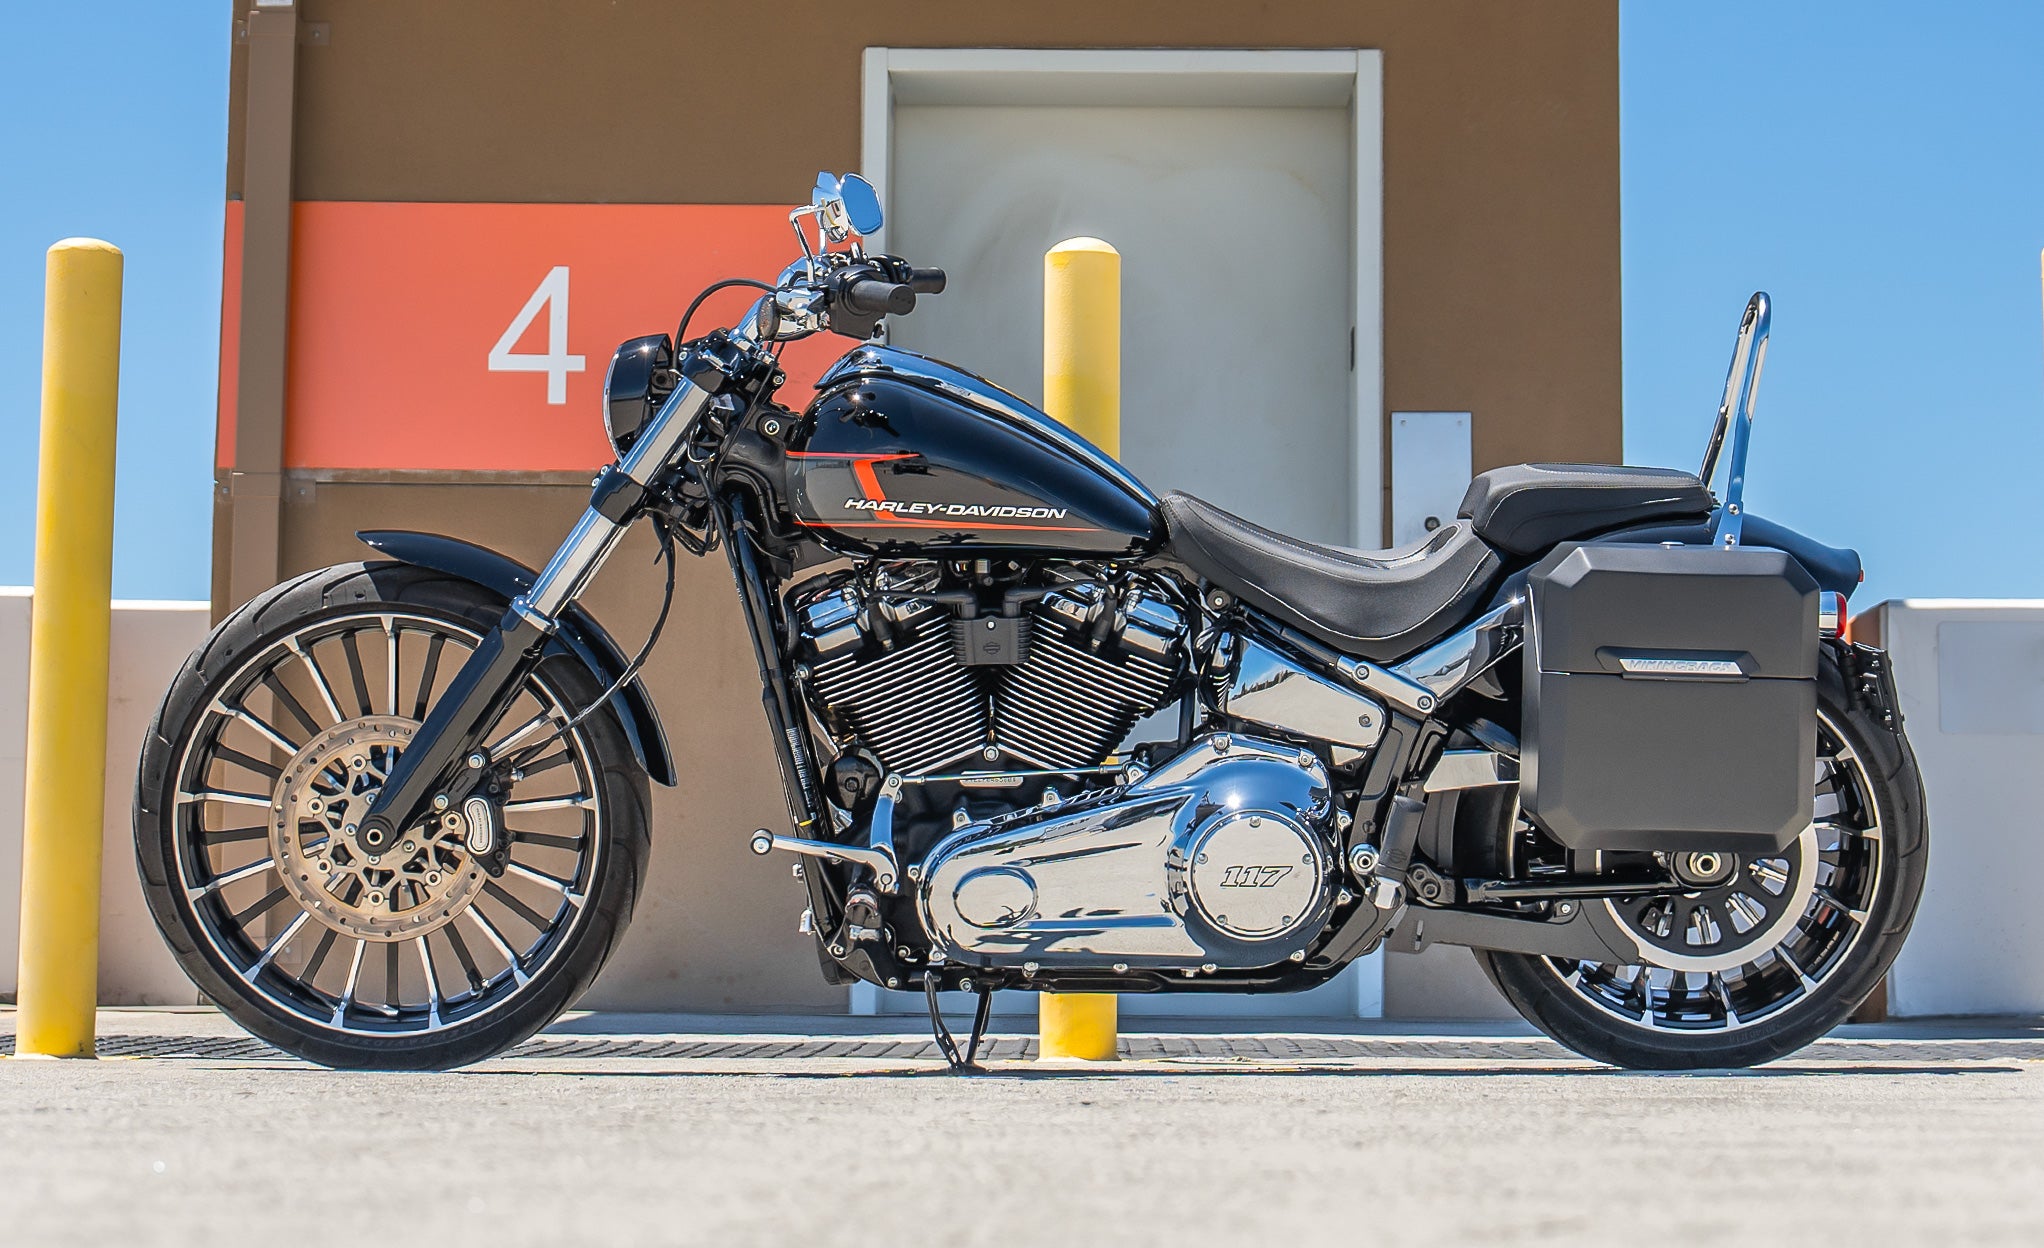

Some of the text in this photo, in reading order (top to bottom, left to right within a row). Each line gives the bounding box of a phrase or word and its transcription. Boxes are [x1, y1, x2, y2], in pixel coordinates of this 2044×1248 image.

[488, 266, 586, 404] 4
[844, 498, 1068, 519] HARLEY-DAVIDSON
[1220, 866, 1293, 887] 117
